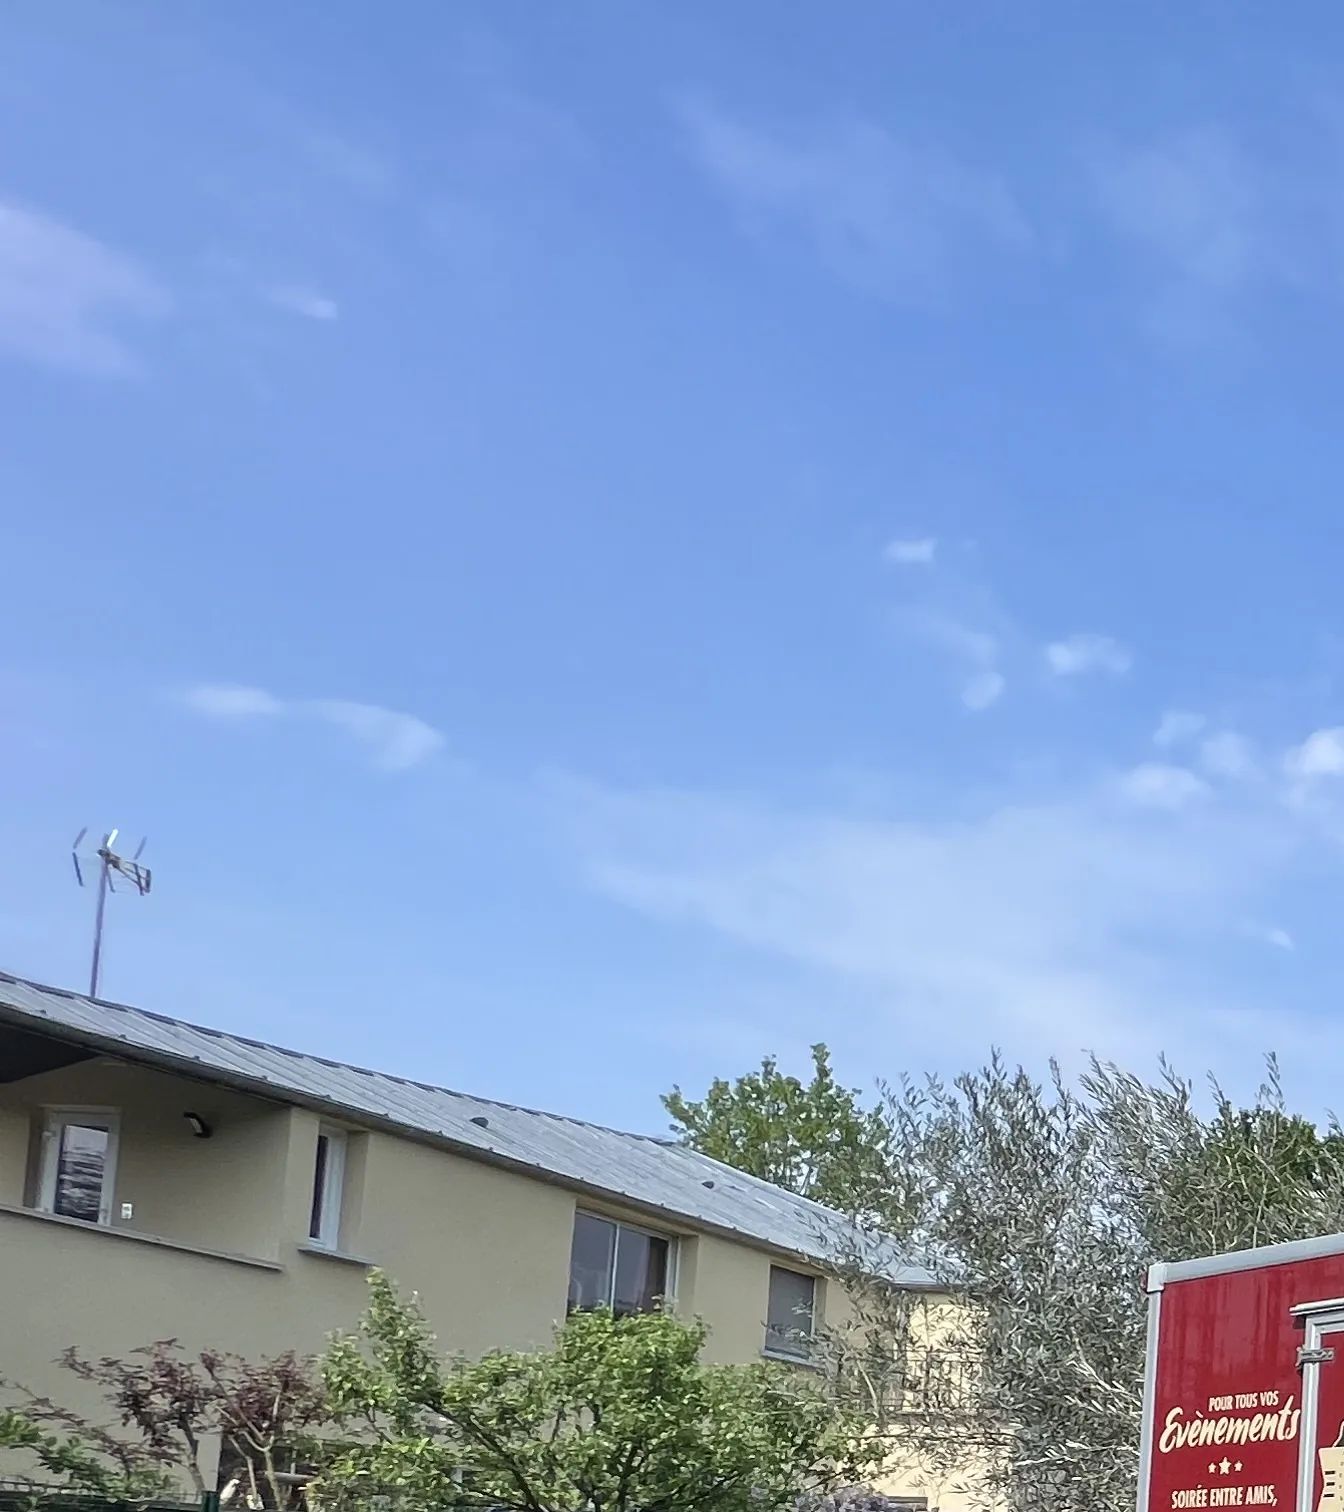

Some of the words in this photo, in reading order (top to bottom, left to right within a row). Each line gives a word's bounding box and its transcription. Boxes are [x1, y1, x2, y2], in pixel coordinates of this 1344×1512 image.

[1208, 1395, 1233, 1412] POUR
[1235, 1392, 1258, 1409] TOUS
[1260, 1390, 1279, 1406] VOS
[1159, 1395, 1301, 1454] Evènements
[1171, 1484, 1208, 1509] SOIRÉE
[1209, 1487, 1244, 1507] ENTRE
[1245, 1485, 1278, 1507] AMIS,
